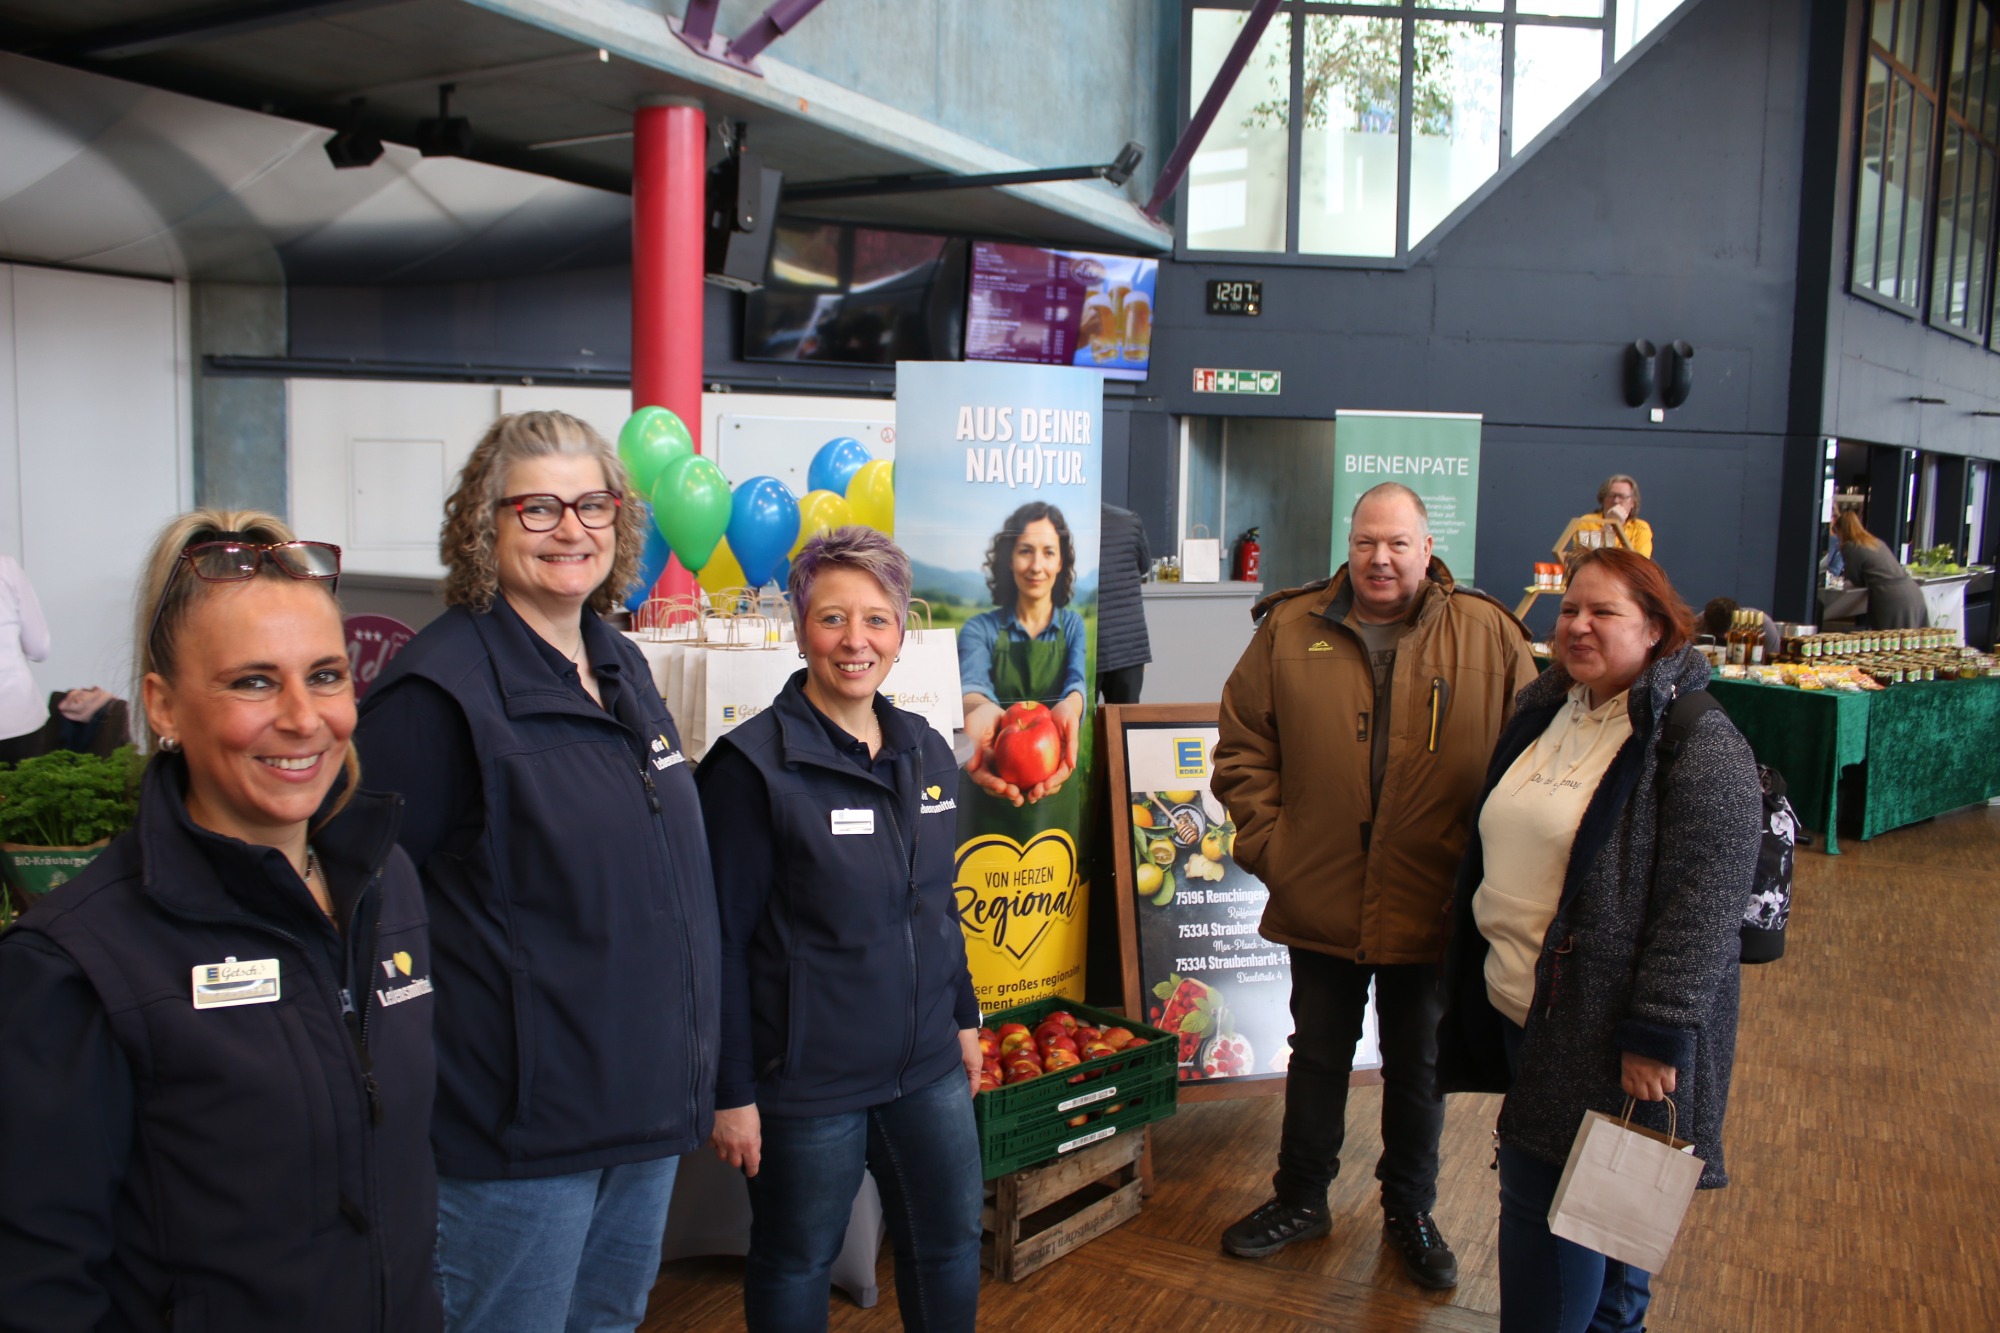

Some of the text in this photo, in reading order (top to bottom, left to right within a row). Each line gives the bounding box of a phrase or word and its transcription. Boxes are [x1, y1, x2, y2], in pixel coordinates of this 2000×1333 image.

[1216, 282, 1252, 301] 12:07
[956, 406, 1091, 446] AUS DEINER
[966, 443, 1087, 488] NA(H)TUR.
[1345, 455, 1469, 476] BIENENPATE
[985, 866, 1054, 889] VON HERZEN
[1176, 891, 1205, 905] 75196
[953, 878, 1078, 948] Regional
[1179, 924, 1209, 938] 75334
[1176, 956, 1206, 972] 75334
[998, 979, 1039, 997] großes
[1041, 963, 1081, 988] regionales
[1277, 970, 1283, 980] 4
